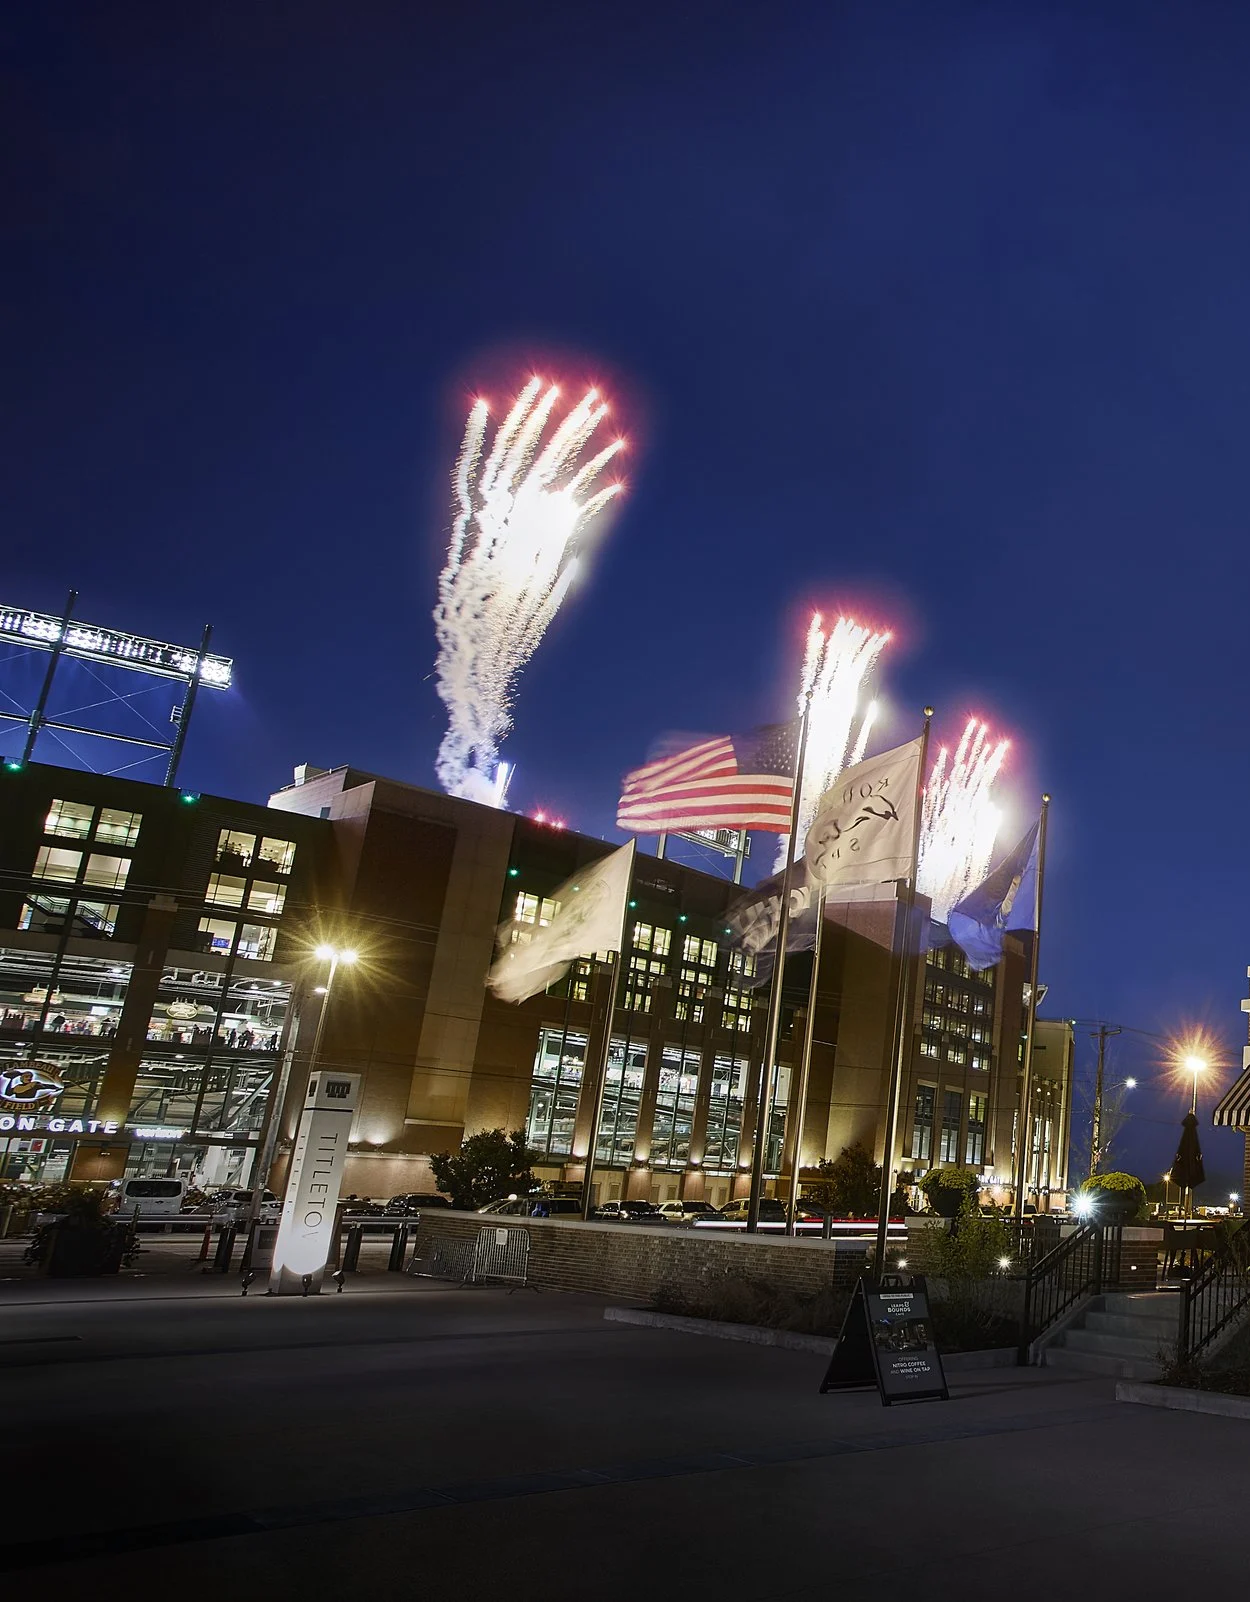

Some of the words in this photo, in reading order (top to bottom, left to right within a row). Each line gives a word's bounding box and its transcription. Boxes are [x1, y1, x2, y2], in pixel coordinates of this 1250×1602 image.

[5, 1060, 56, 1075] LAMBEAU
[4, 1101, 36, 1110] FIELD
[47, 1119, 119, 1134] GATE
